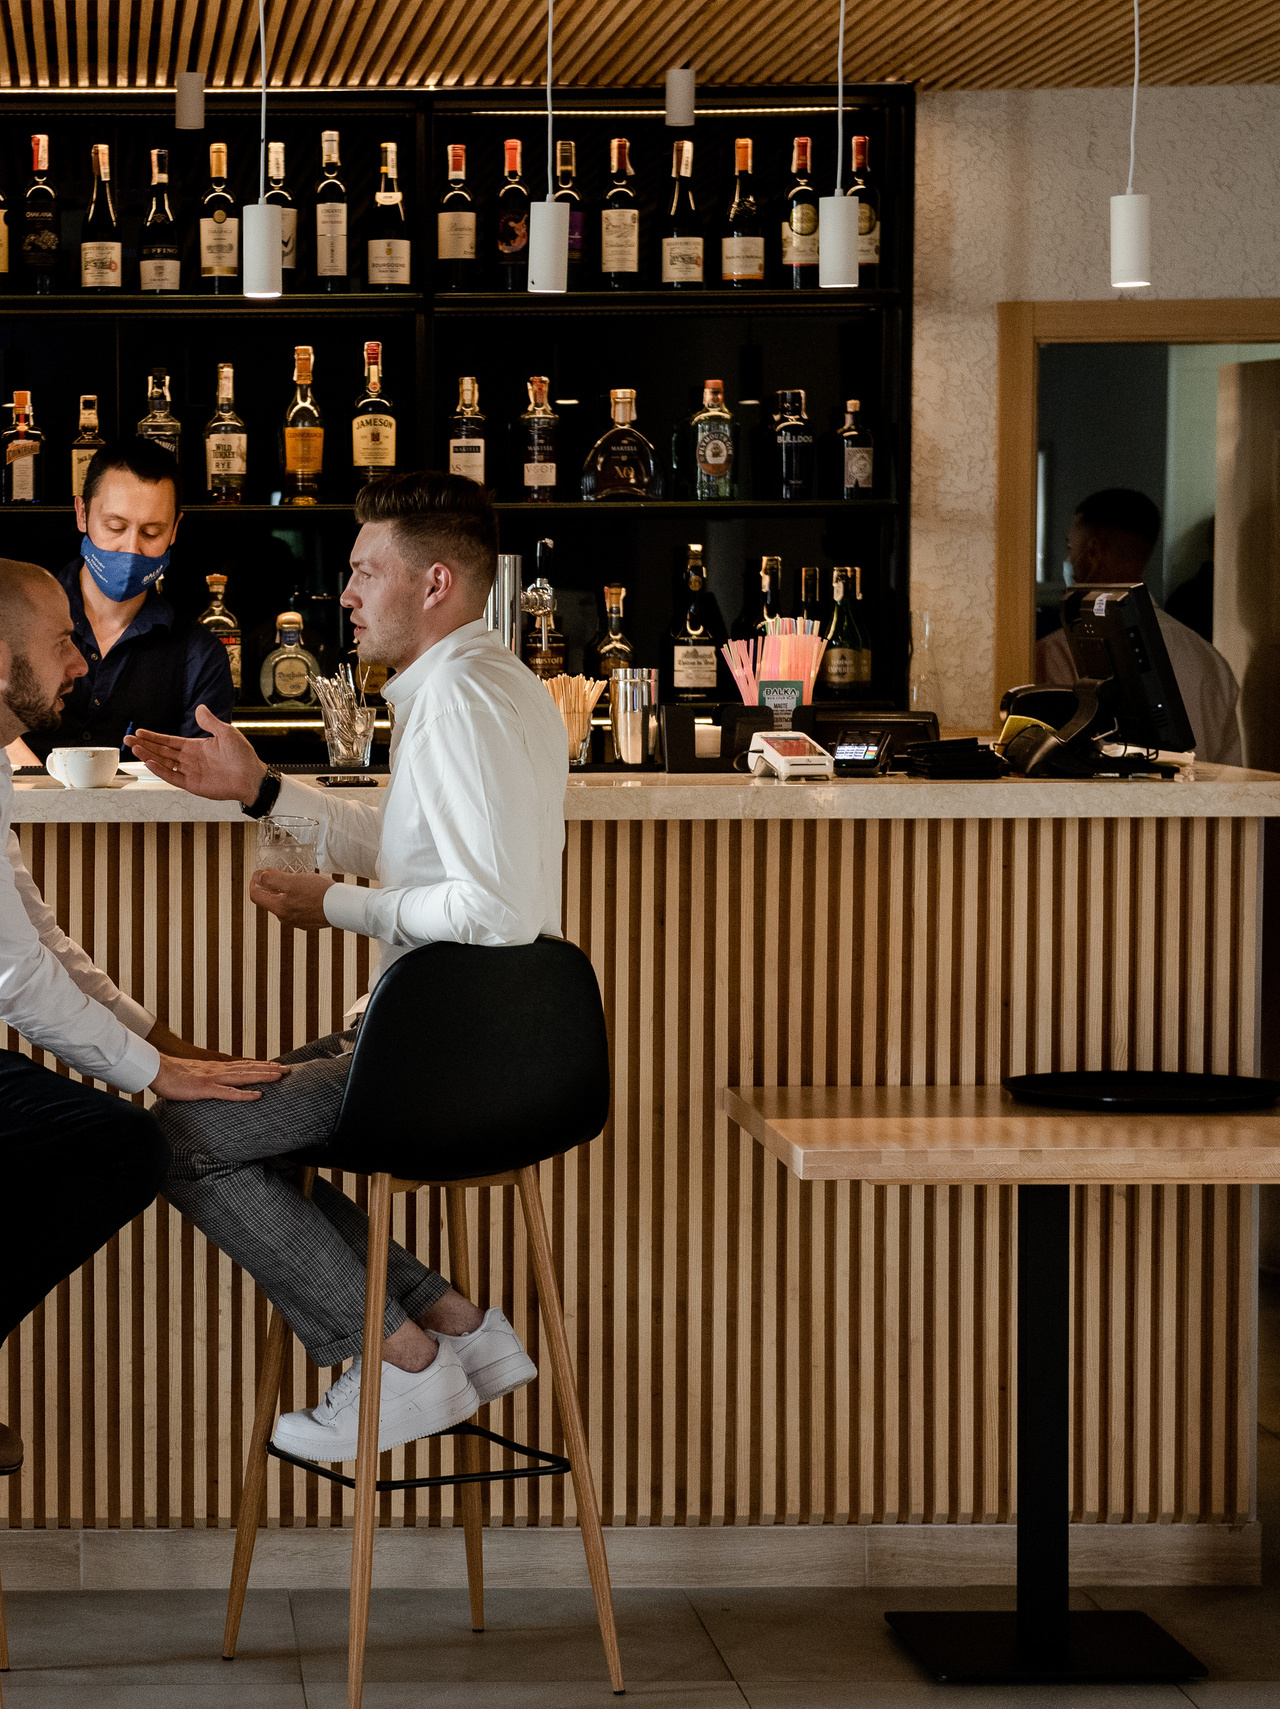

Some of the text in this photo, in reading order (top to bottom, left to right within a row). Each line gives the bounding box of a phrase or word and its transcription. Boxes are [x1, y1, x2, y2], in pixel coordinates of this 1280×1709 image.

[356, 418, 393, 430] JAMESON
[215, 443, 232, 451] WILD
[698, 433, 727, 456] PLYMOUTH
[212, 450, 235, 459] TURKEY
[451, 464, 462, 472] VS
[614, 465, 635, 479] XO
[765, 688, 797, 696] BALKA
